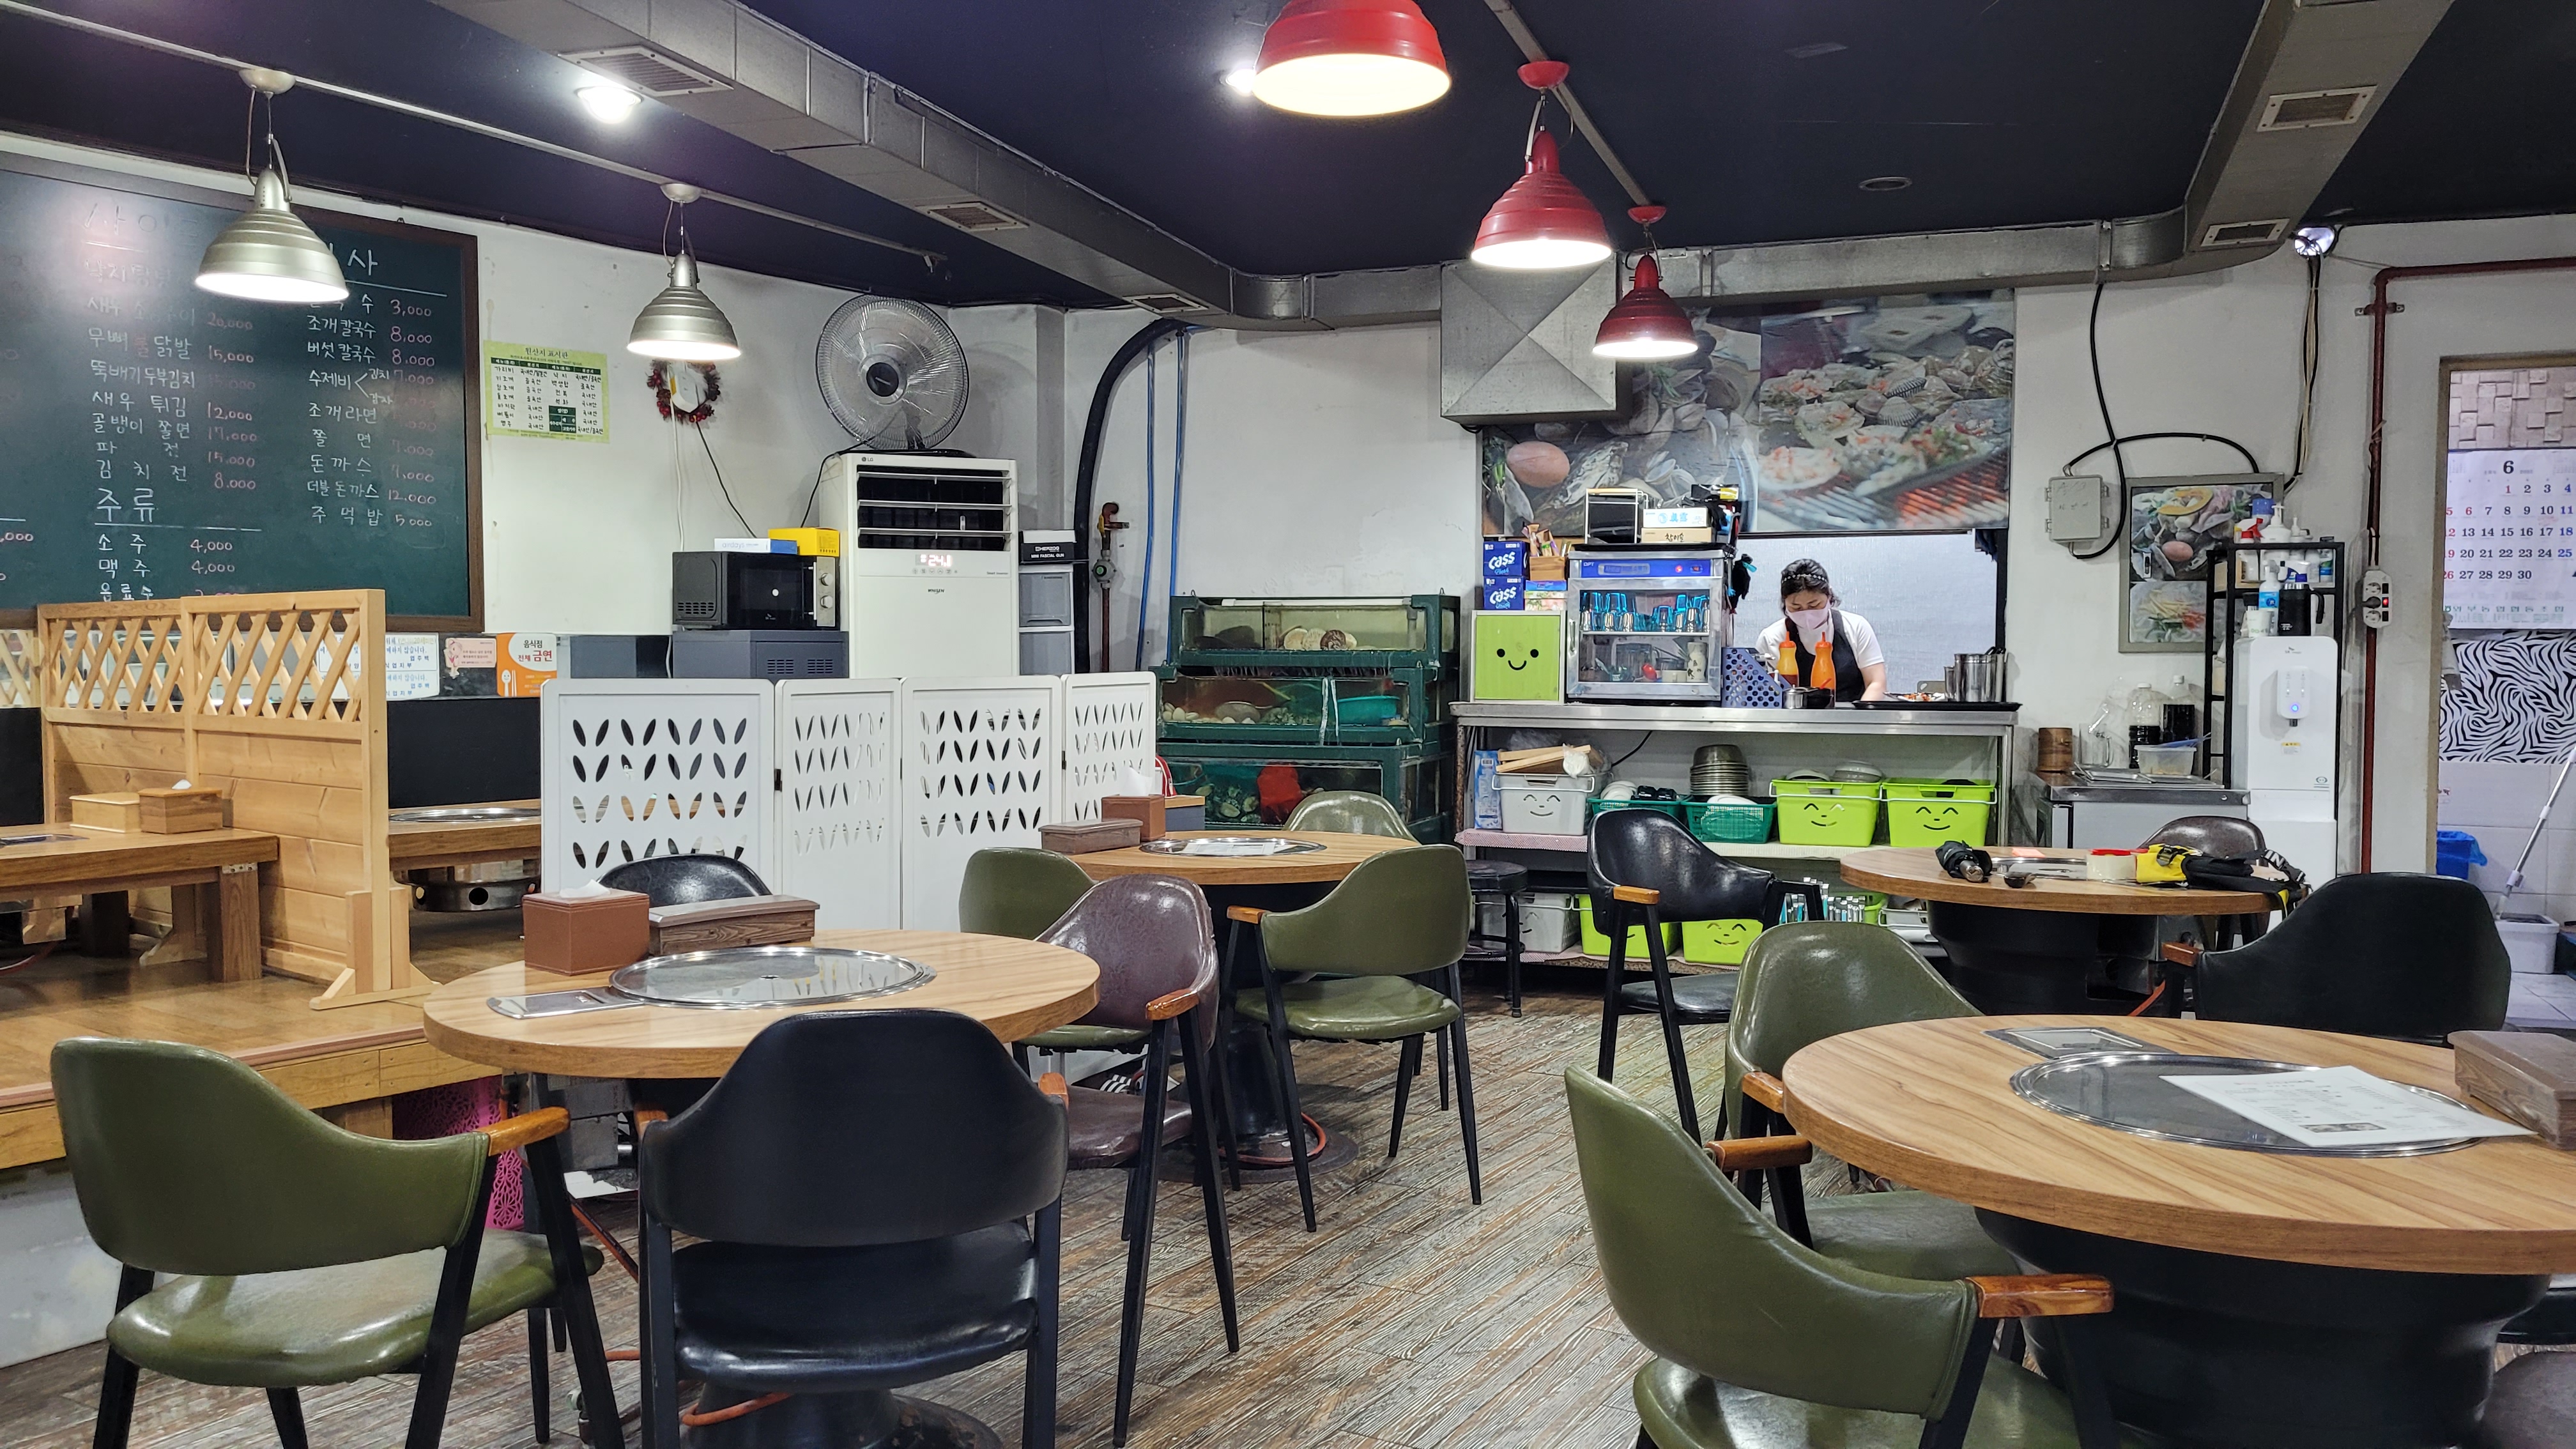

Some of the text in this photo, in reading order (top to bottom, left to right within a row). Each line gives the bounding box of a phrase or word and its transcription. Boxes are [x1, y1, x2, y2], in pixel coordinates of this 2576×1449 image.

[390, 299, 432, 317] 3,000
[209, 345, 254, 363] 15,000
[309, 370, 351, 390] 수제비
[93, 391, 253, 421] 새우 튀김 12,000
[92, 413, 143, 434] 골뱅이
[158, 420, 190, 440] 쫄면
[2503, 460, 2515, 475] 6
[2505, 484, 2572, 493] 1 2 3 4
[96, 487, 156, 523] 주류
[2446, 505, 2573, 516] 5 6 7 8 9 10 11
[1664, 532, 1685, 542] 참이슬
[2462, 527, 2475, 537] 13
[2481, 527, 2494, 537] 14
[2501, 527, 2514, 537] 15
[2520, 527, 2533, 537] 16
[2540, 527, 2553, 537] 17
[2559, 527, 2573, 537] 18
[190, 539, 233, 553] 4,000
[1488, 551, 1516, 570] Cass
[2460, 549, 2474, 558] 20
[2480, 549, 2493, 558] 21
[2499, 549, 2513, 558] 22
[2518, 549, 2533, 558] 23
[2538, 549, 2552, 558] 24
[2557, 549, 2572, 558] 25
[191, 560, 235, 574] 4,000
[2460, 571, 2474, 579] 27
[2479, 571, 2493, 579] 28
[2498, 571, 2512, 579] 29
[2518, 571, 2532, 579] 30
[1489, 586, 1517, 604] Cass
[523, 640, 543, 648] 음식점
[532, 650, 553, 662] 금연
